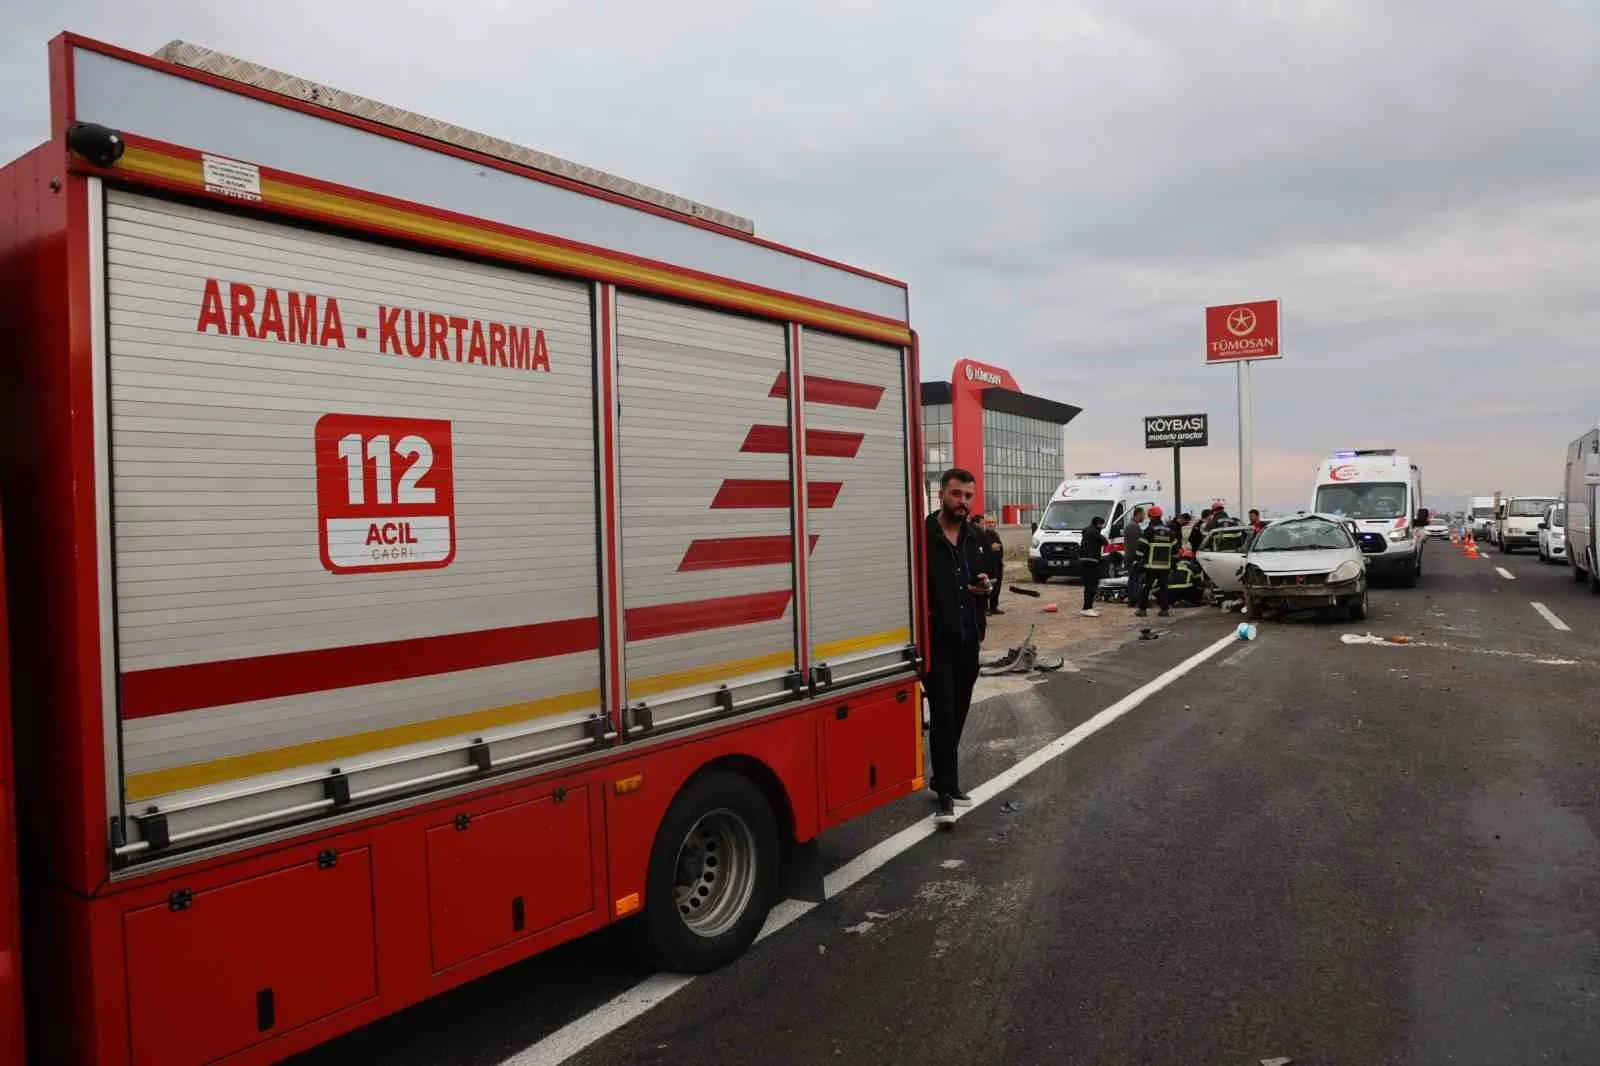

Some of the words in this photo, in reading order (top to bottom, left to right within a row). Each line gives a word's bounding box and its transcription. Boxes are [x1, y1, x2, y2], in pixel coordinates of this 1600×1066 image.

[197, 278, 346, 349] ARAMA
[378, 305, 551, 372] KURTARMA
[1211, 336, 1273, 352] TÜMOSAN
[338, 433, 436, 504] 112
